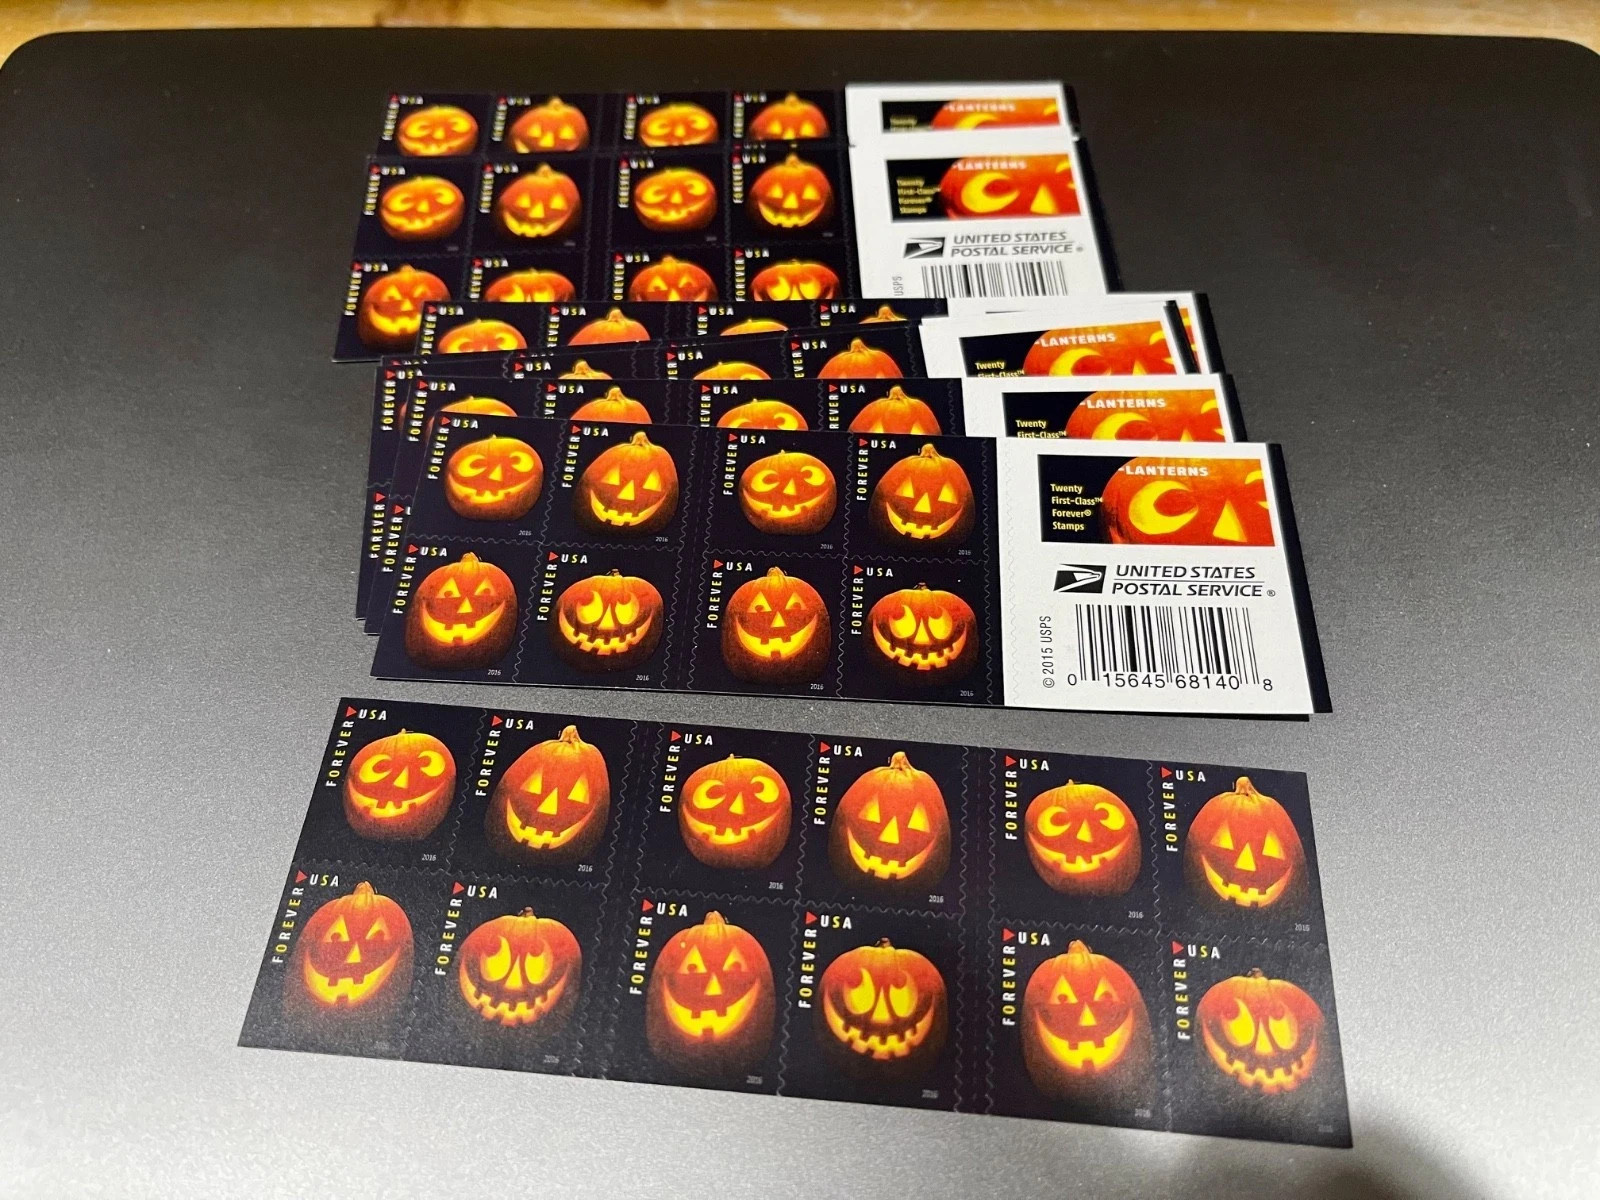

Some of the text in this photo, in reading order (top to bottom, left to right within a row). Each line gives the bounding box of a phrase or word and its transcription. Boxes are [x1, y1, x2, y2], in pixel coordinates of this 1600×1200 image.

[953, 231, 1067, 245] UNITED STATES
[625, 253, 650, 263] USA
[745, 249, 769, 258] USA
[951, 244, 1073, 258] POSTAL SERVICE
[363, 263, 389, 272] USA
[483, 258, 509, 268] USA
[469, 268, 483, 300] REVER
[613, 262, 625, 300] OREVER
[893, 276, 904, 296] USPS
[344, 271, 362, 316] FOREVER
[438, 306, 464, 316] USA
[561, 306, 586, 316] USA
[708, 306, 734, 316] USA
[830, 304, 856, 314] USA
[802, 340, 828, 351] USA
[678, 351, 704, 361] USA
[525, 361, 552, 371] USA
[792, 351, 805, 378] EVER
[975, 360, 1006, 371] Twenty
[397, 370, 424, 380] USA
[429, 382, 456, 392] USA
[558, 384, 585, 394] USA
[713, 384, 739, 395] USA
[840, 383, 866, 394] USA
[381, 380, 397, 430] FOREVER
[829, 392, 840, 429] REVER
[408, 391, 428, 442] FOREVER
[453, 419, 479, 430] USA
[582, 426, 609, 437] USA
[1015, 419, 1047, 431] Twenty
[740, 434, 766, 444] USA
[871, 439, 897, 449] USA
[428, 427, 450, 480] FOREVER
[562, 435, 581, 488] FOREVER
[723, 443, 738, 496] FOREVER
[857, 448, 869, 501] FOREVER
[1050, 483, 1083, 495] Twenty
[370, 503, 385, 559] FOREVER
[1052, 520, 1085, 532] Stamps
[382, 516, 403, 573] FOREVER
[420, 546, 448, 557] USA
[561, 553, 588, 564] USA
[726, 561, 753, 572] USA
[866, 566, 894, 578] USA
[1115, 564, 1256, 579] UNITED STATES
[393, 556, 417, 614] FOREVER
[537, 563, 557, 621] FOREVER
[1112, 583, 1182, 596] POSTAL
[707, 571, 723, 629] FOREVER
[851, 577, 864, 635] FOREVER
[1039, 615, 1051, 643] USPS
[1041, 644, 1054, 675] 2015
[1067, 673, 1273, 691] 0 15645 68140 8
[358, 708, 387, 721] USA
[505, 718, 534, 731] USA
[684, 733, 713, 746] USA
[326, 720, 354, 787] FOREVER
[833, 744, 863, 757] USA
[476, 729, 501, 797] FOREVER
[1019, 758, 1050, 771] USA
[660, 744, 680, 813] FOREVER
[1175, 769, 1206, 783] USA
[814, 756, 830, 825] FOREVER
[1005, 770, 1018, 840] FOREVER
[1162, 782, 1178, 852] FOREVER
[309, 873, 339, 887] USA
[467, 885, 498, 899] USA
[656, 902, 688, 916] USA
[272, 886, 304, 963] FOREVER
[820, 915, 853, 930] USA
[435, 898, 463, 976] FOREVER
[1018, 931, 1051, 946] USA
[630, 915, 653, 995] FOREVER
[1187, 943, 1221, 959] USA
[798, 928, 817, 1009] FOREVER
[1002, 945, 1016, 1026] FOREVER
[1173, 958, 1191, 1040] FOREVER
